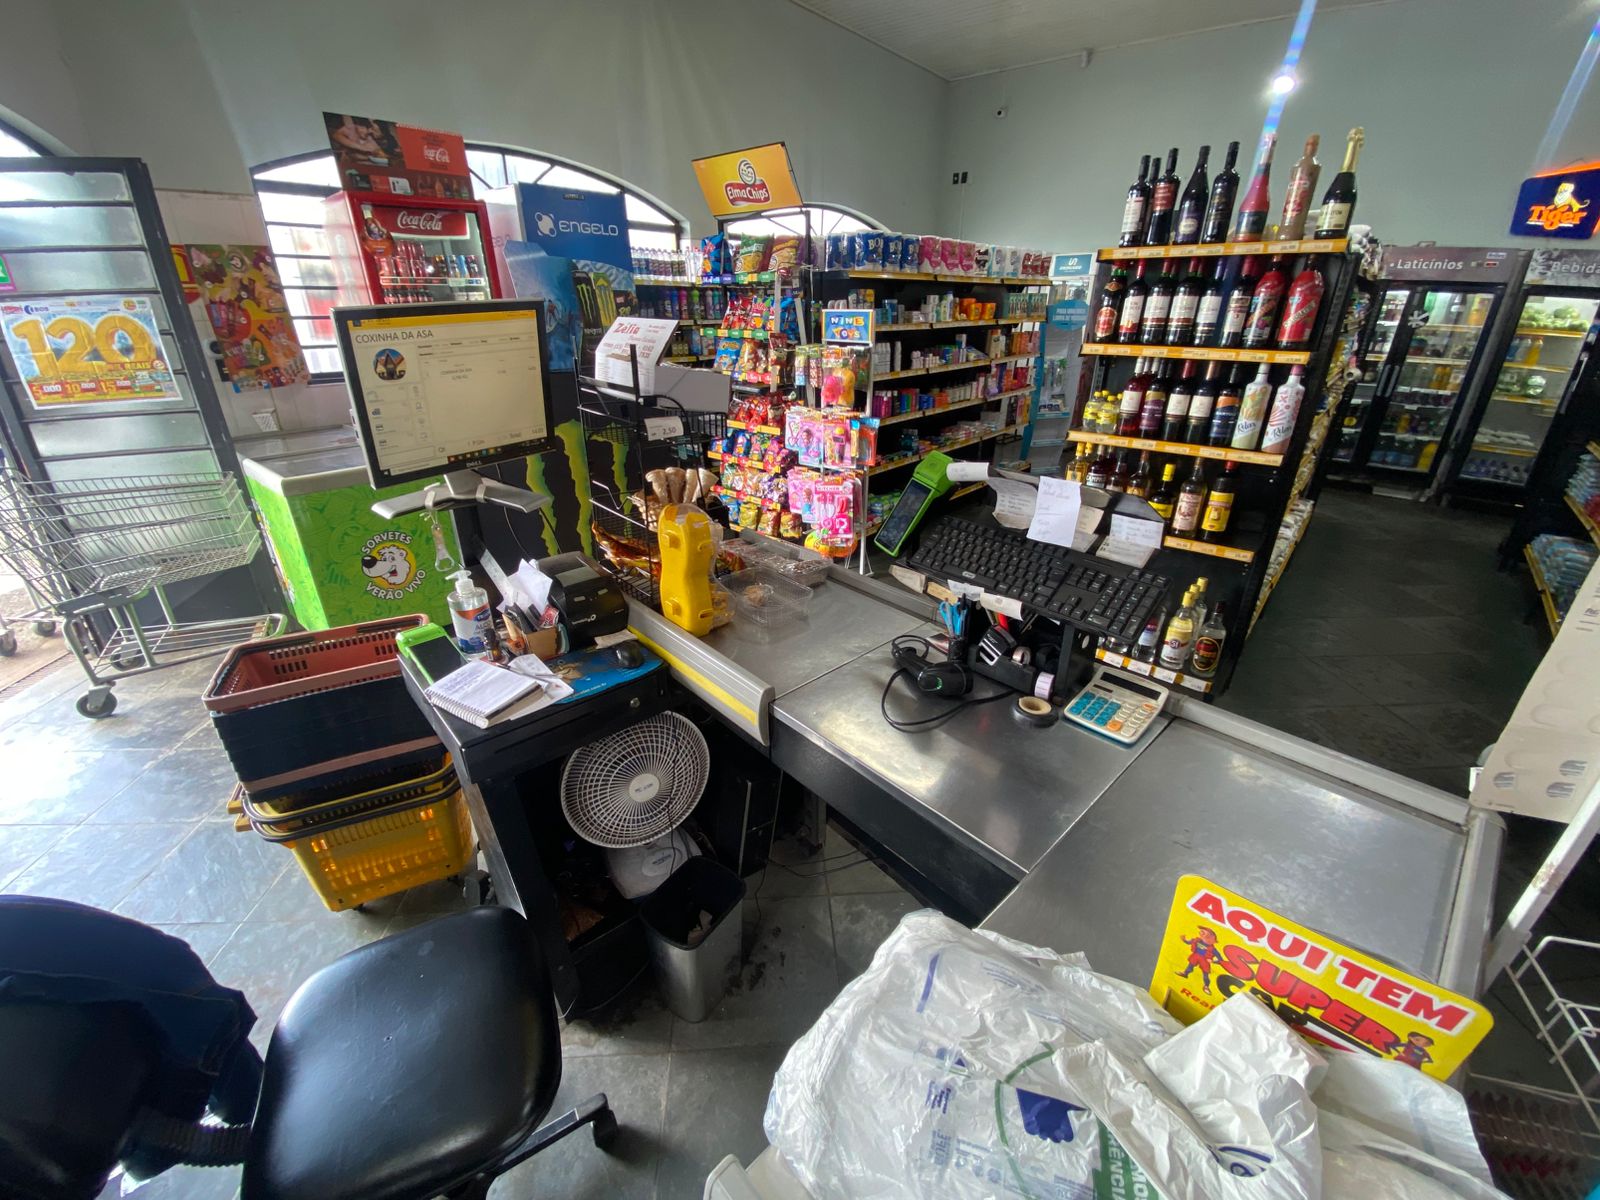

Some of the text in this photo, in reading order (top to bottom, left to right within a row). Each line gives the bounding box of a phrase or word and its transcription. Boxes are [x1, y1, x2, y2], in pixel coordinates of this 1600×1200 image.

[726, 186, 769, 201] Elma Chips
[1528, 204, 1588, 230] Tiger
[558, 220, 619, 236] ENGELO
[1397, 258, 1464, 271] Laticínios
[830, 316, 865, 327] NINE
[355, 329, 434, 344] COXINHA DA ASA
[832, 326, 861, 340] TOYS
[11, 315, 157, 378] 120
[361, 531, 412, 555] SORVETES
[366, 569, 426, 600] VERÃO VIVO
[1190, 890, 1472, 1033] AQUI TEM
[1220, 944, 1403, 1056] SUPER
